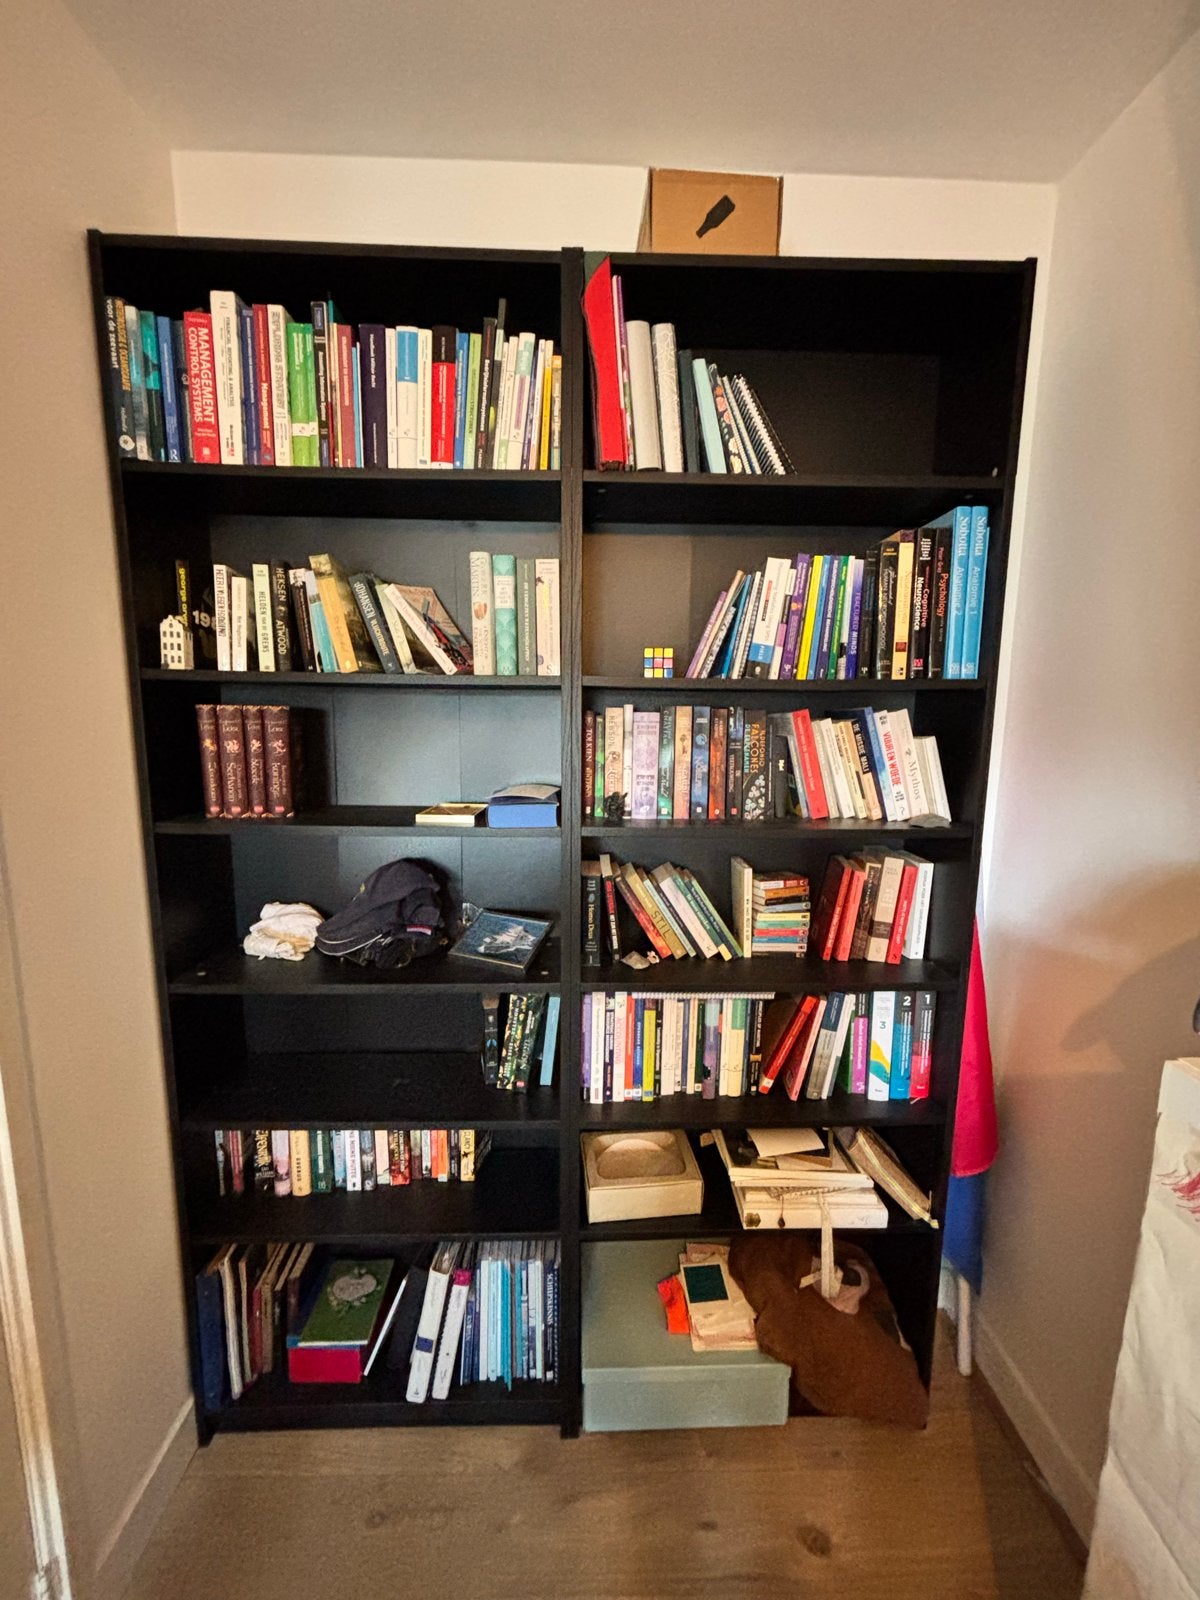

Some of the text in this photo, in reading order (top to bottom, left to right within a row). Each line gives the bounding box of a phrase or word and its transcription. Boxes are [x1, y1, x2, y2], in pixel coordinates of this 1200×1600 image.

[107, 299, 119, 368] voor de zeevaart
[188, 327, 202, 423] CONTROL SYSTEMS
[198, 327, 215, 424] MANAGEMENT
[260, 382, 269, 429] Management
[975, 516, 987, 556] Sobotta
[276, 568, 286, 601] HEKSEN
[471, 557, 480, 597] MARTIN
[954, 516, 970, 616] Sobotta Anatomie 2
[259, 591, 267, 615] HELDEN
[354, 581, 376, 619] JOHANSEN
[914, 577, 924, 631] Neuroscience
[936, 573, 948, 617] Psychology
[970, 566, 981, 608] Anatomie
[852, 591, 861, 630] FRACTURED
[880, 593, 888, 650] NEUROPSYCHOLOGY
[921, 588, 930, 628] Cognitive
[276, 620, 286, 655] ATWOOD
[750, 724, 759, 773] FALCONES
[853, 723, 869, 773] DE MISSIE MALI
[883, 731, 901, 786] VUUR EN WOEDE
[907, 761, 921, 800] Mythos
[651, 911, 670, 940] STIL
[903, 995, 911, 1006] 2
[925, 994, 930, 1004] 1
[615, 1017, 623, 1064] ACCOUNTING
[879, 1021, 886, 1029] 3
[464, 1131, 472, 1150] CLANCY
